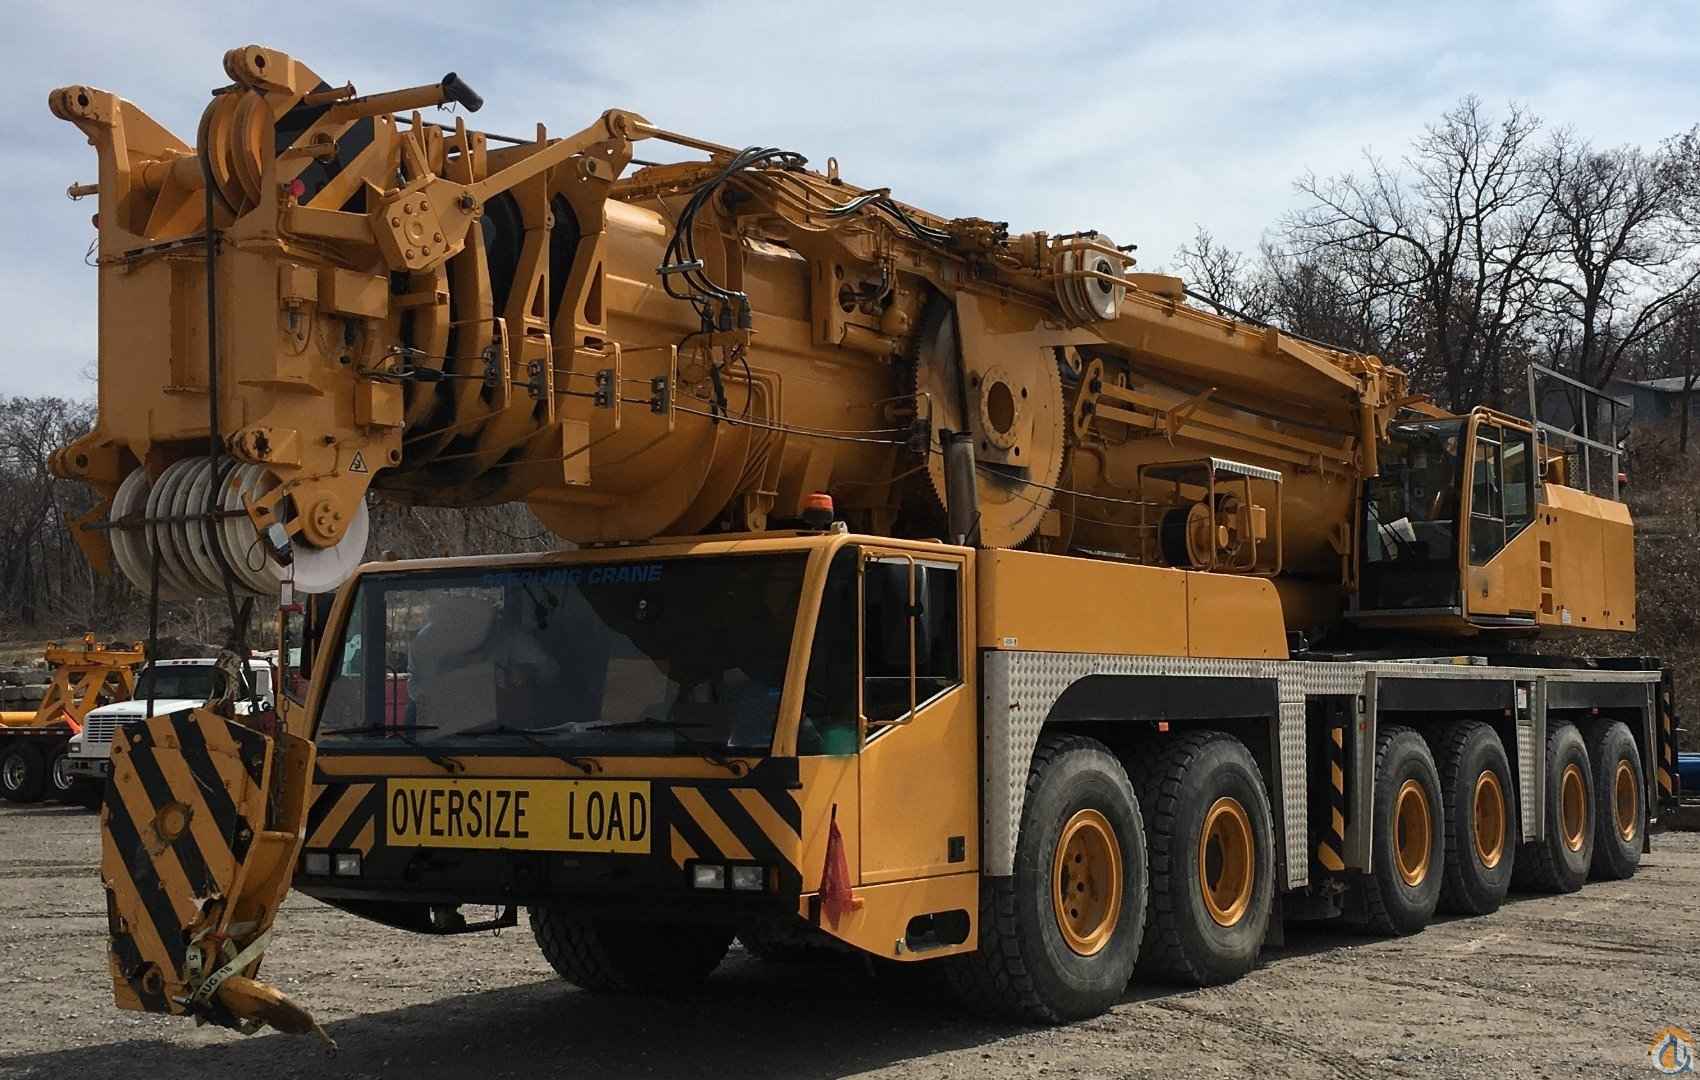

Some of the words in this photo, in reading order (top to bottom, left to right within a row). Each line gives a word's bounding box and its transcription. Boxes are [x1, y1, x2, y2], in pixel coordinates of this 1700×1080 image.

[590, 564, 664, 584] CRANE
[392, 788, 530, 839] OVERSIZE
[568, 790, 647, 842] LOAD
